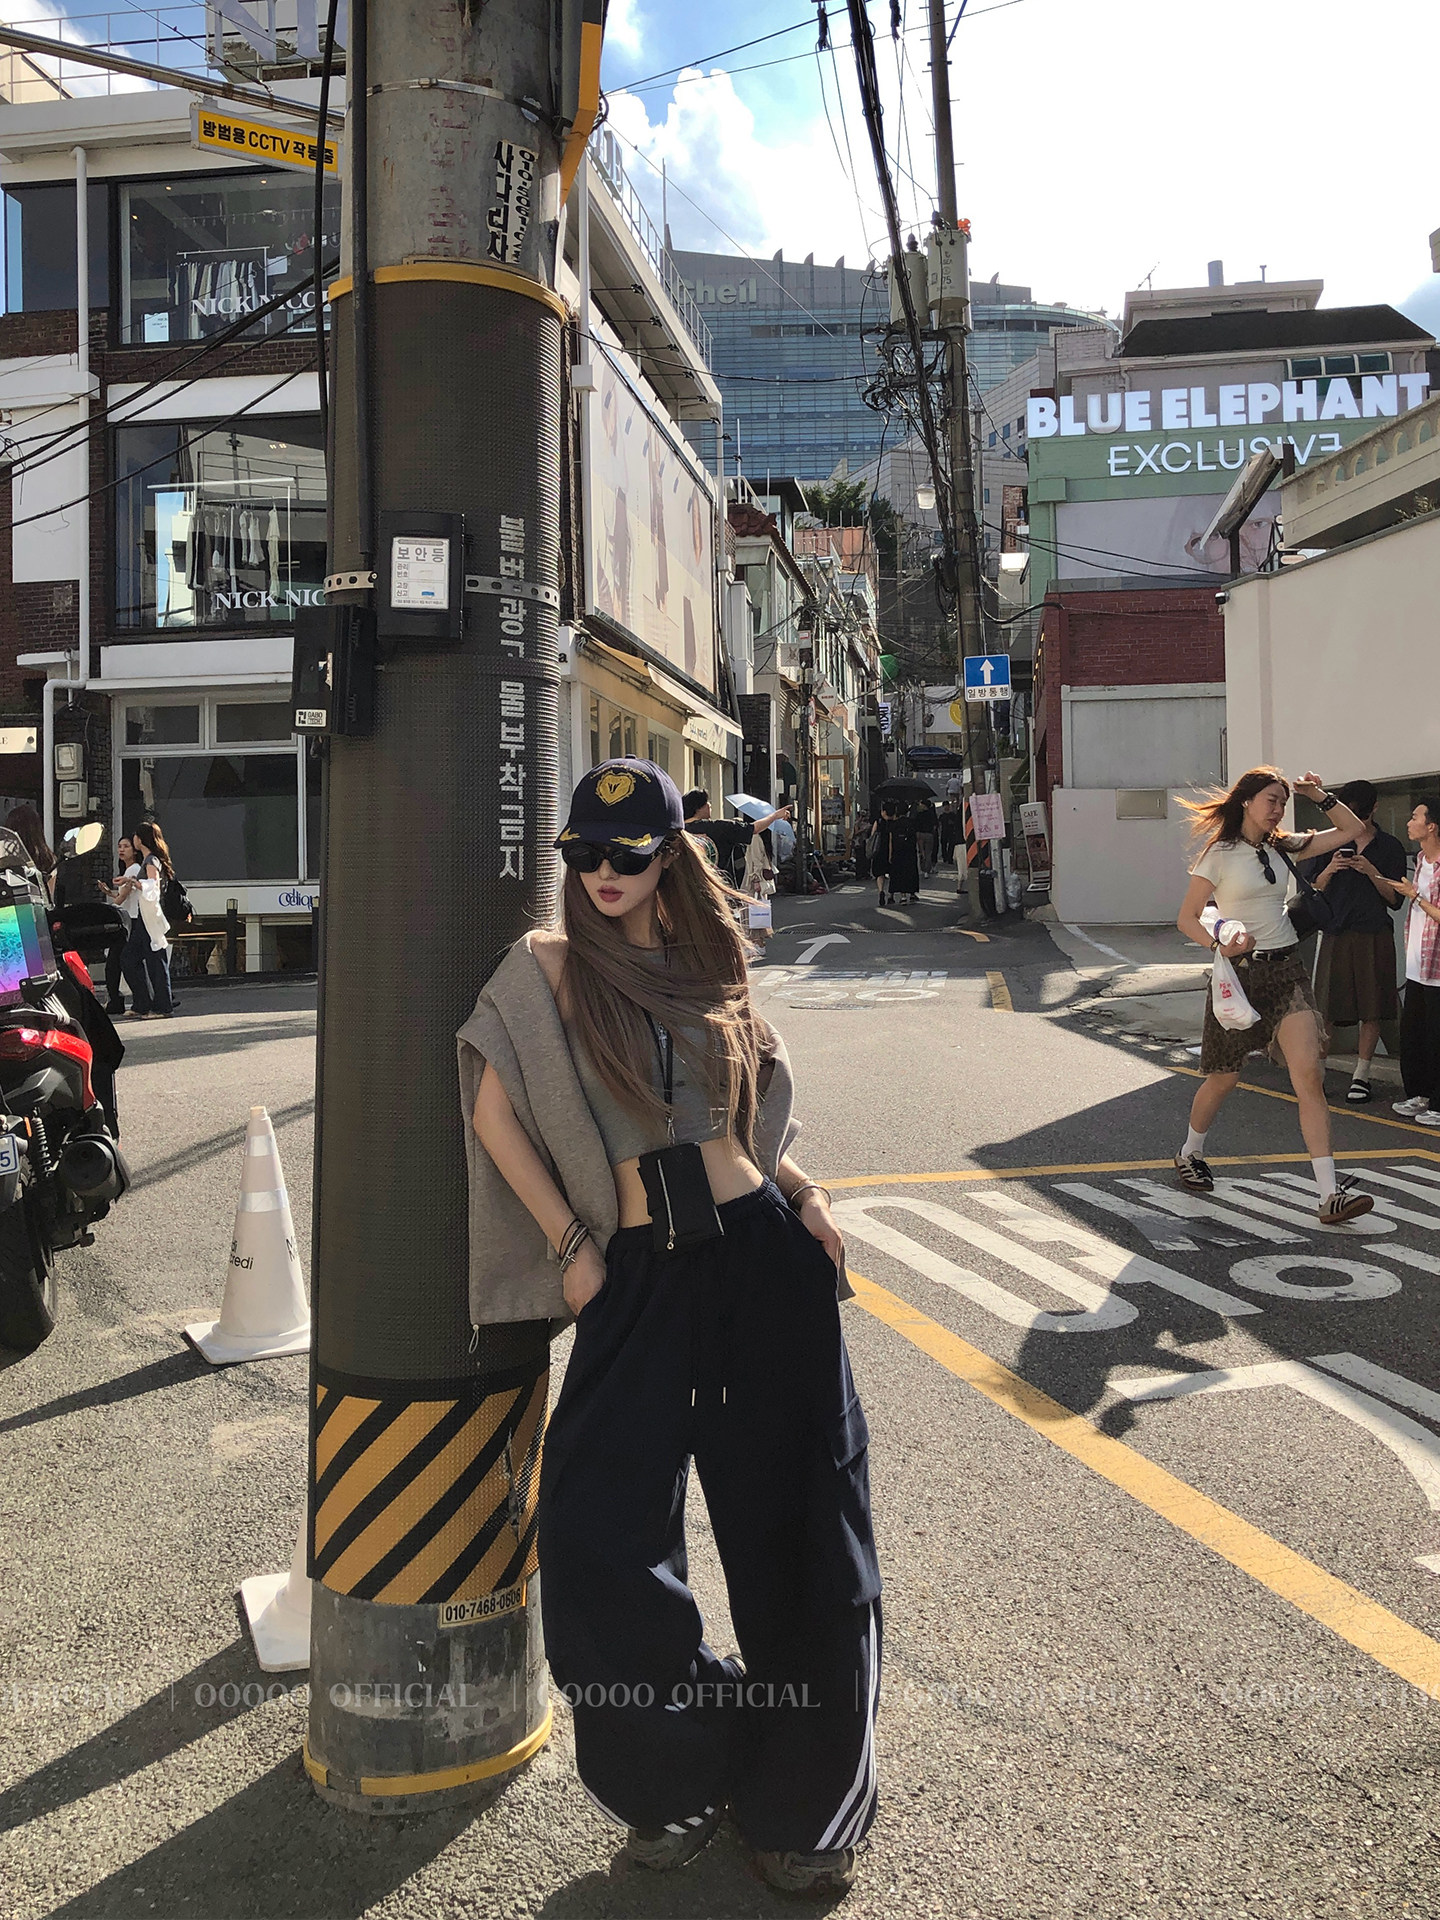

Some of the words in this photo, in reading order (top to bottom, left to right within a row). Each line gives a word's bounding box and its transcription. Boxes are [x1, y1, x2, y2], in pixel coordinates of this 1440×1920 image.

[203, 119, 246, 145] 방범용
[248, 131, 290, 154] CCTV
[487, 140, 514, 262] 사다리차
[191, 295, 254, 316] NICK
[1027, 390, 1152, 439] BLUE
[1161, 372, 1430, 430] ELEPHANT
[397, 547, 445, 563] 보안등
[215, 590, 279, 610] NICK
[967, 687, 1008, 698] 일방통행
[1023, 809, 1039, 818] CAFE
